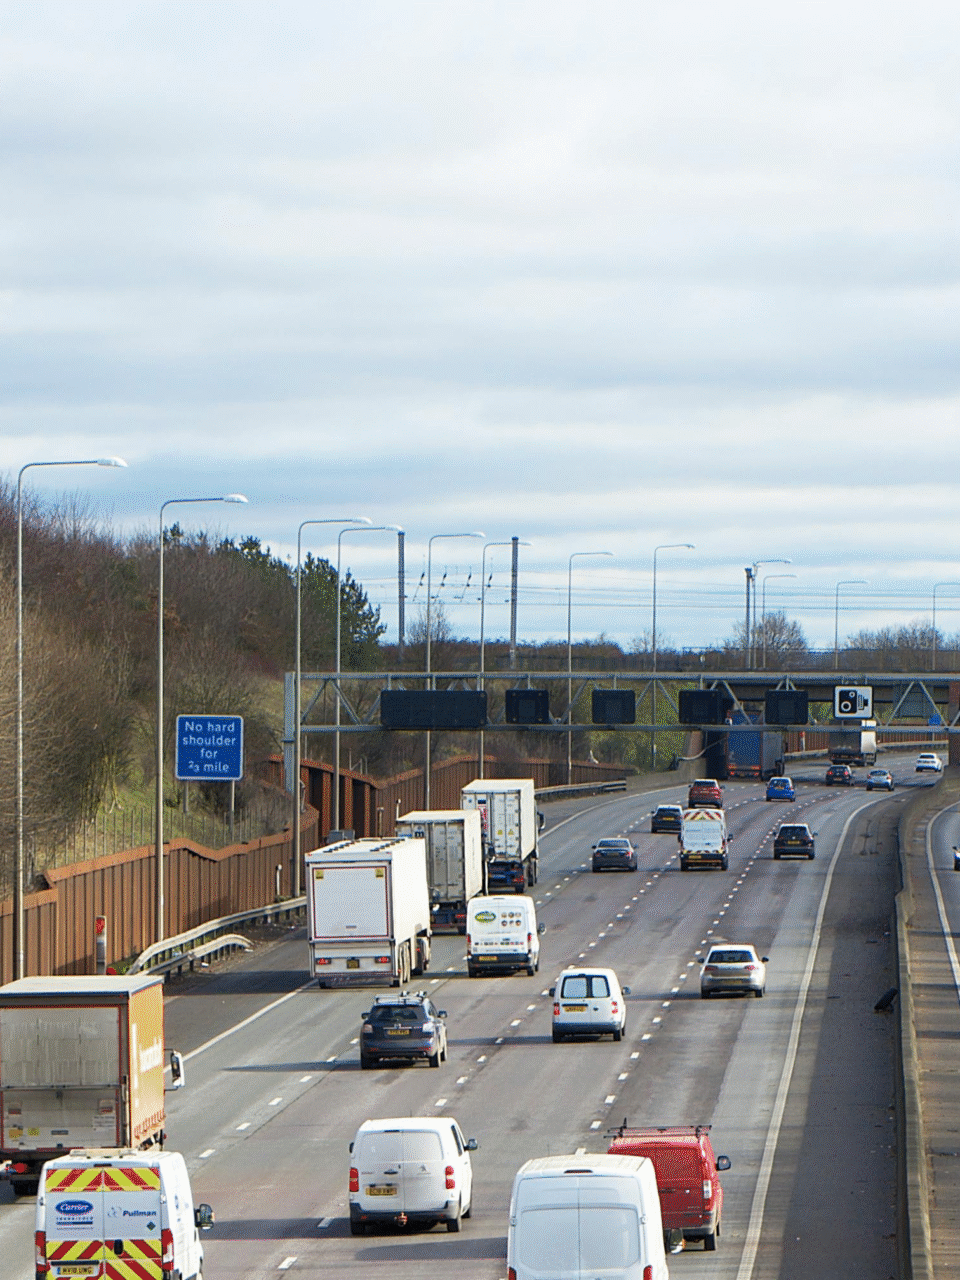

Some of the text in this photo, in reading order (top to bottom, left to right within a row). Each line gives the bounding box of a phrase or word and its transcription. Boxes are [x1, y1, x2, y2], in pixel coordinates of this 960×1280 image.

[185, 721, 235, 732] No hard
[182, 735, 236, 746] shoulder
[200, 748, 218, 758] for
[203, 761, 229, 773] mile
[60, 1203, 89, 1212] Carrier
